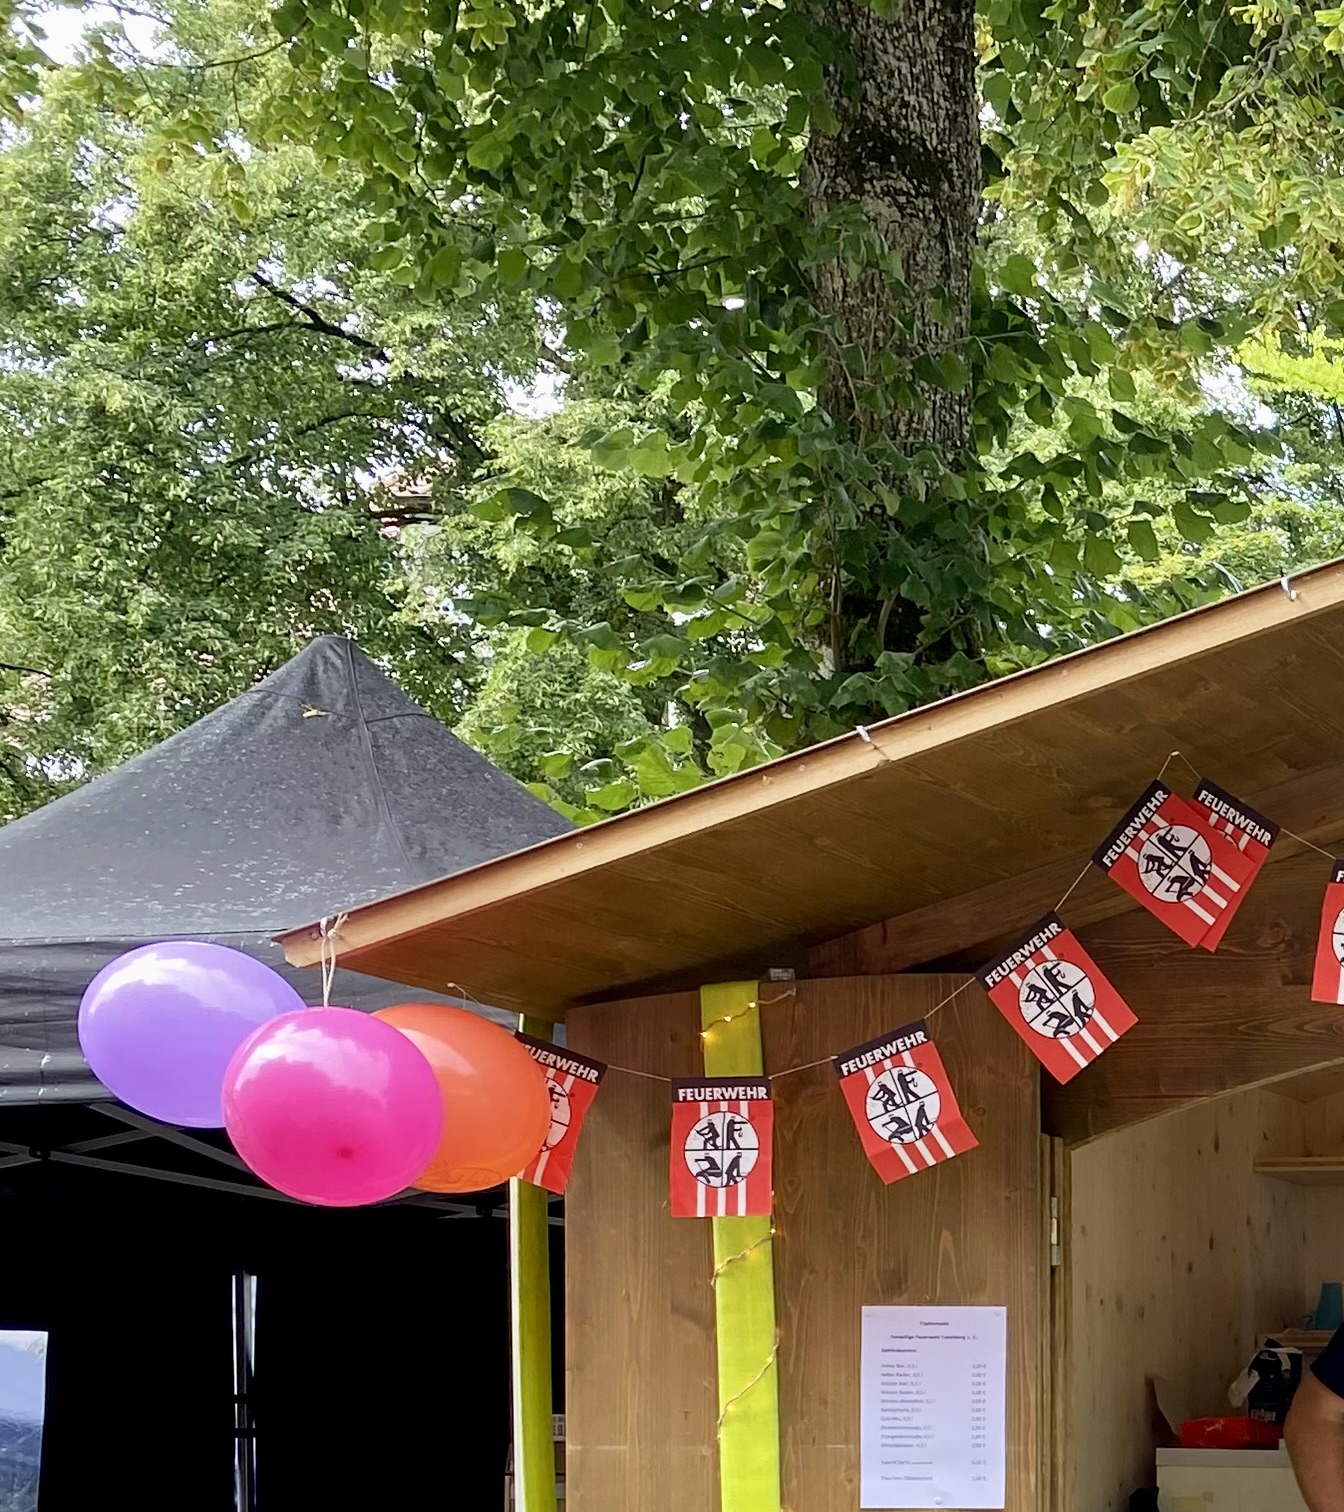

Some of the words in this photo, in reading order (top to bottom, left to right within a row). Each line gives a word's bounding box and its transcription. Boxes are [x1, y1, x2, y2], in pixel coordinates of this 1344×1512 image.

[1101, 788, 1170, 869] FEUERWEHR
[1197, 788, 1273, 846] FEUERWEHR
[985, 920, 1063, 990] FEUERWEHR
[840, 1029, 927, 1078] FEUERWEHR
[677, 1086, 768, 1103] FEUERWEHR
